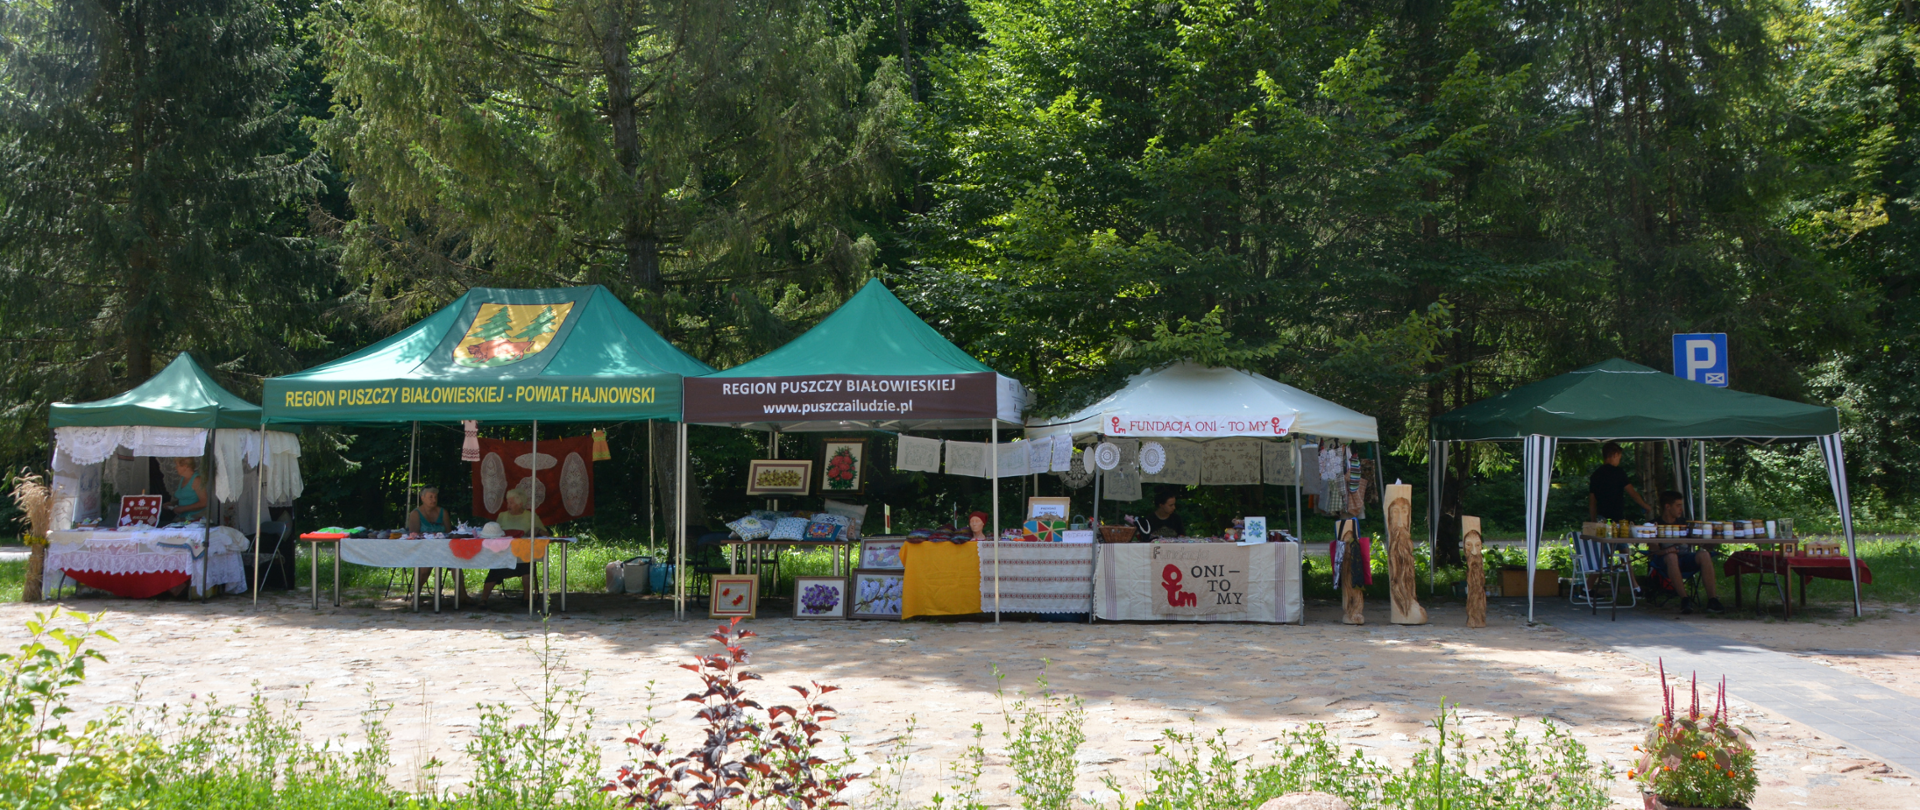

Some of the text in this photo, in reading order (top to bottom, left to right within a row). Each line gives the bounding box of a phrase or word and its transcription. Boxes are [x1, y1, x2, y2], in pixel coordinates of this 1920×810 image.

[1686, 340, 1716, 380] P
[722, 379, 956, 395] REGION PUSZCZY BIAŁOWIESKIEJ
[285, 390, 335, 407] REGION
[338, 387, 399, 406] PUSZCZY
[401, 386, 504, 403] BIAŁOWIESKIEJ
[515, 386, 568, 402] POWIAT
[571, 386, 655, 403] HAJNOWSKI
[763, 400, 913, 415] www.puszczailudzie.pl
[1129, 420, 1192, 434] FUNDACJA
[1228, 421, 1245, 432] TO
[1248, 420, 1269, 432] MY
[1191, 565, 1224, 578] ONI
[1207, 579, 1231, 592] TO
[1216, 592, 1243, 605] MY
